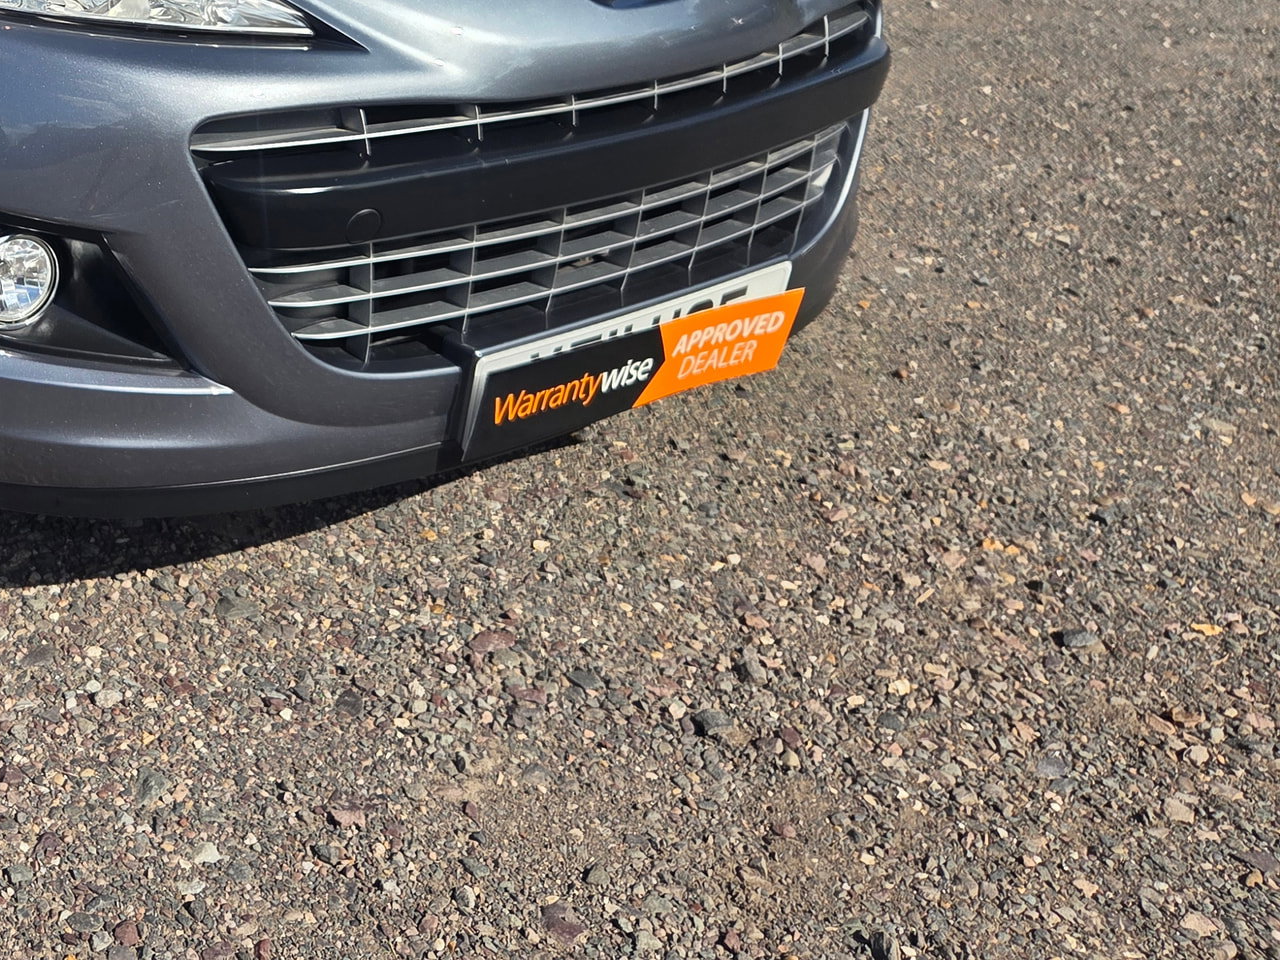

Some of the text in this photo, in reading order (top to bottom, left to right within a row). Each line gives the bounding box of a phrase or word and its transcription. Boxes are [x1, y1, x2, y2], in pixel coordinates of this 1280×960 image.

[672, 310, 786, 358] APPROVED
[677, 339, 758, 381] DEALER
[493, 356, 655, 426] Warrantywise
